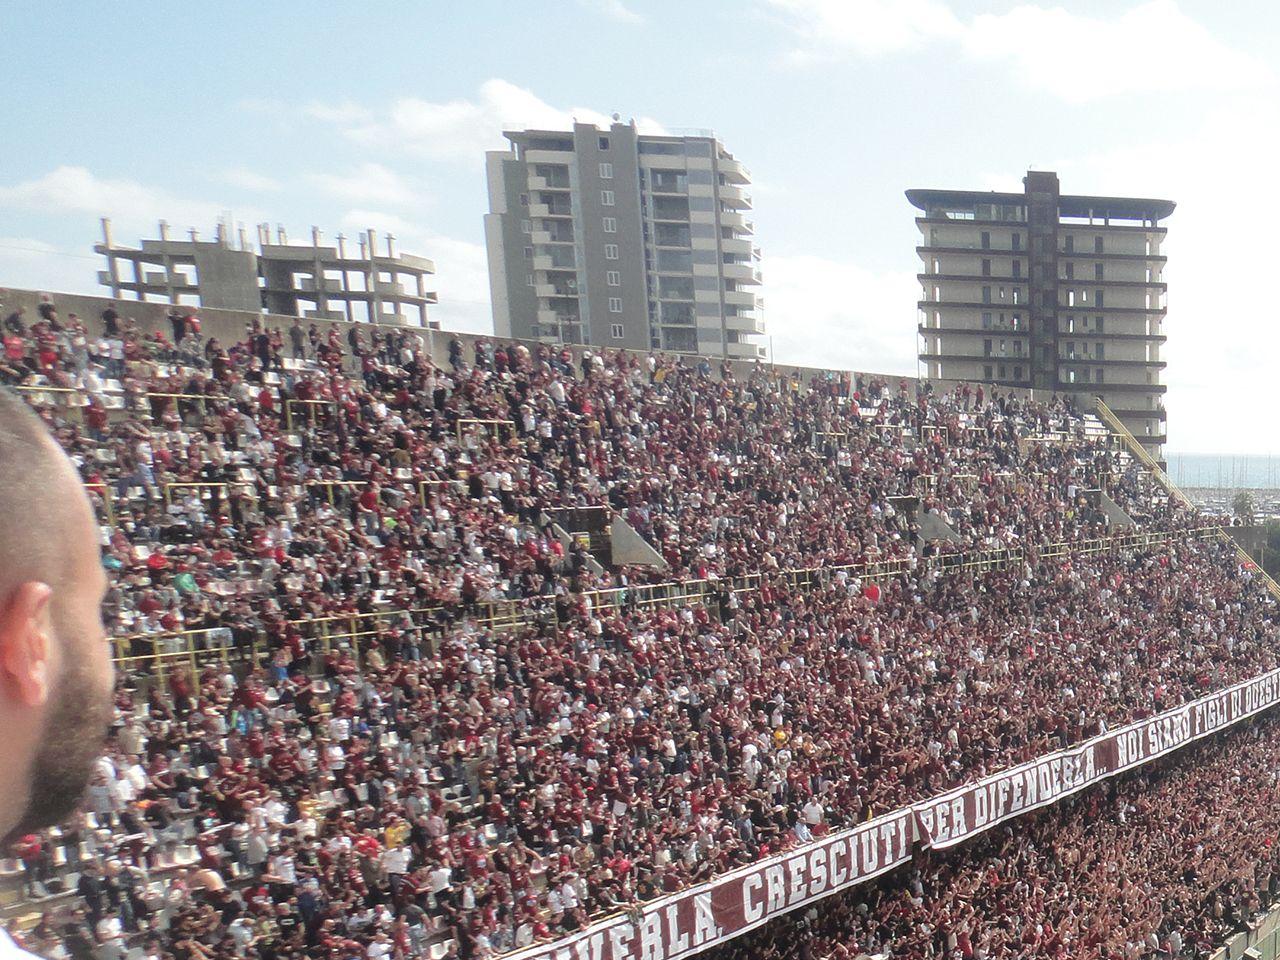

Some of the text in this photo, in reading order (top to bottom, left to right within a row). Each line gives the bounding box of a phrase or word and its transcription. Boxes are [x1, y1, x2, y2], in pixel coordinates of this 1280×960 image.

[743, 817, 907, 923] CRESCIUTI
[920, 797, 967, 843] PER
[1117, 728, 1144, 768] NOI
[1148, 708, 1191, 755] SIAMO
[1195, 696, 1227, 735] FIGLI
[1231, 689, 1242, 719] DI
